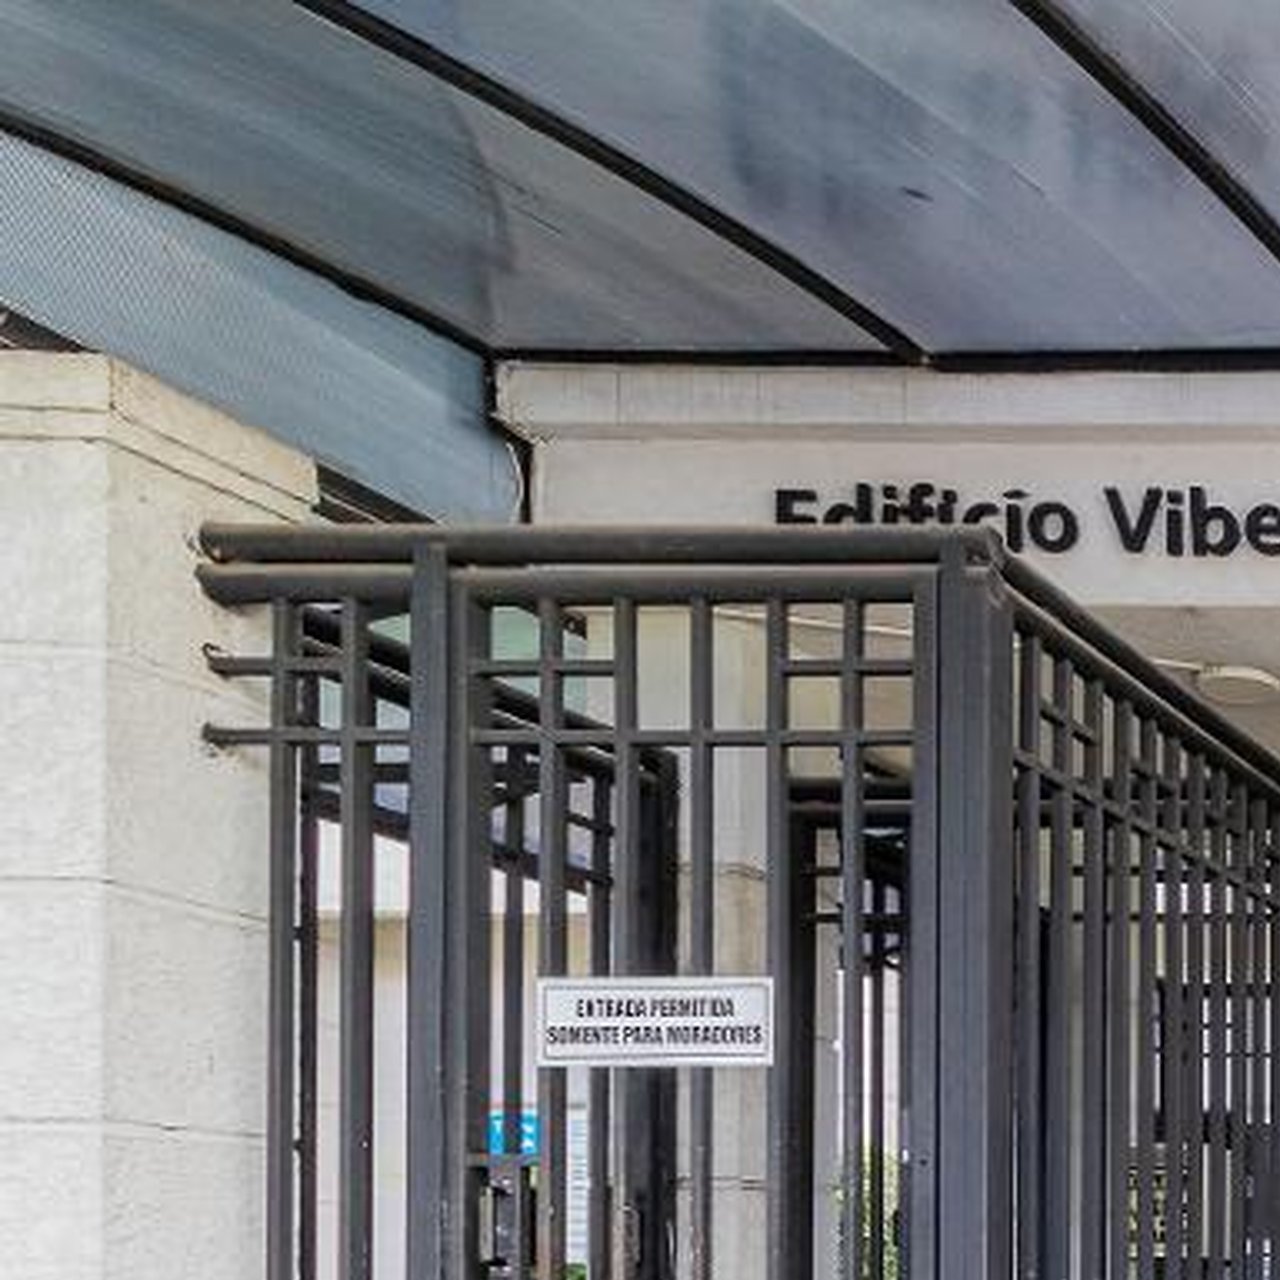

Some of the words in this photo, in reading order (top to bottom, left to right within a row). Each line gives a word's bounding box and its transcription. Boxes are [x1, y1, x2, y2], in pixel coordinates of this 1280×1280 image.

[575, 998, 648, 1018] ENTRADA
[650, 998, 735, 1018] PERMITIDA
[546, 1025, 620, 1045] SOMENTE
[622, 1026, 664, 1044] PARA
[666, 1025, 762, 1045] MORADORES
